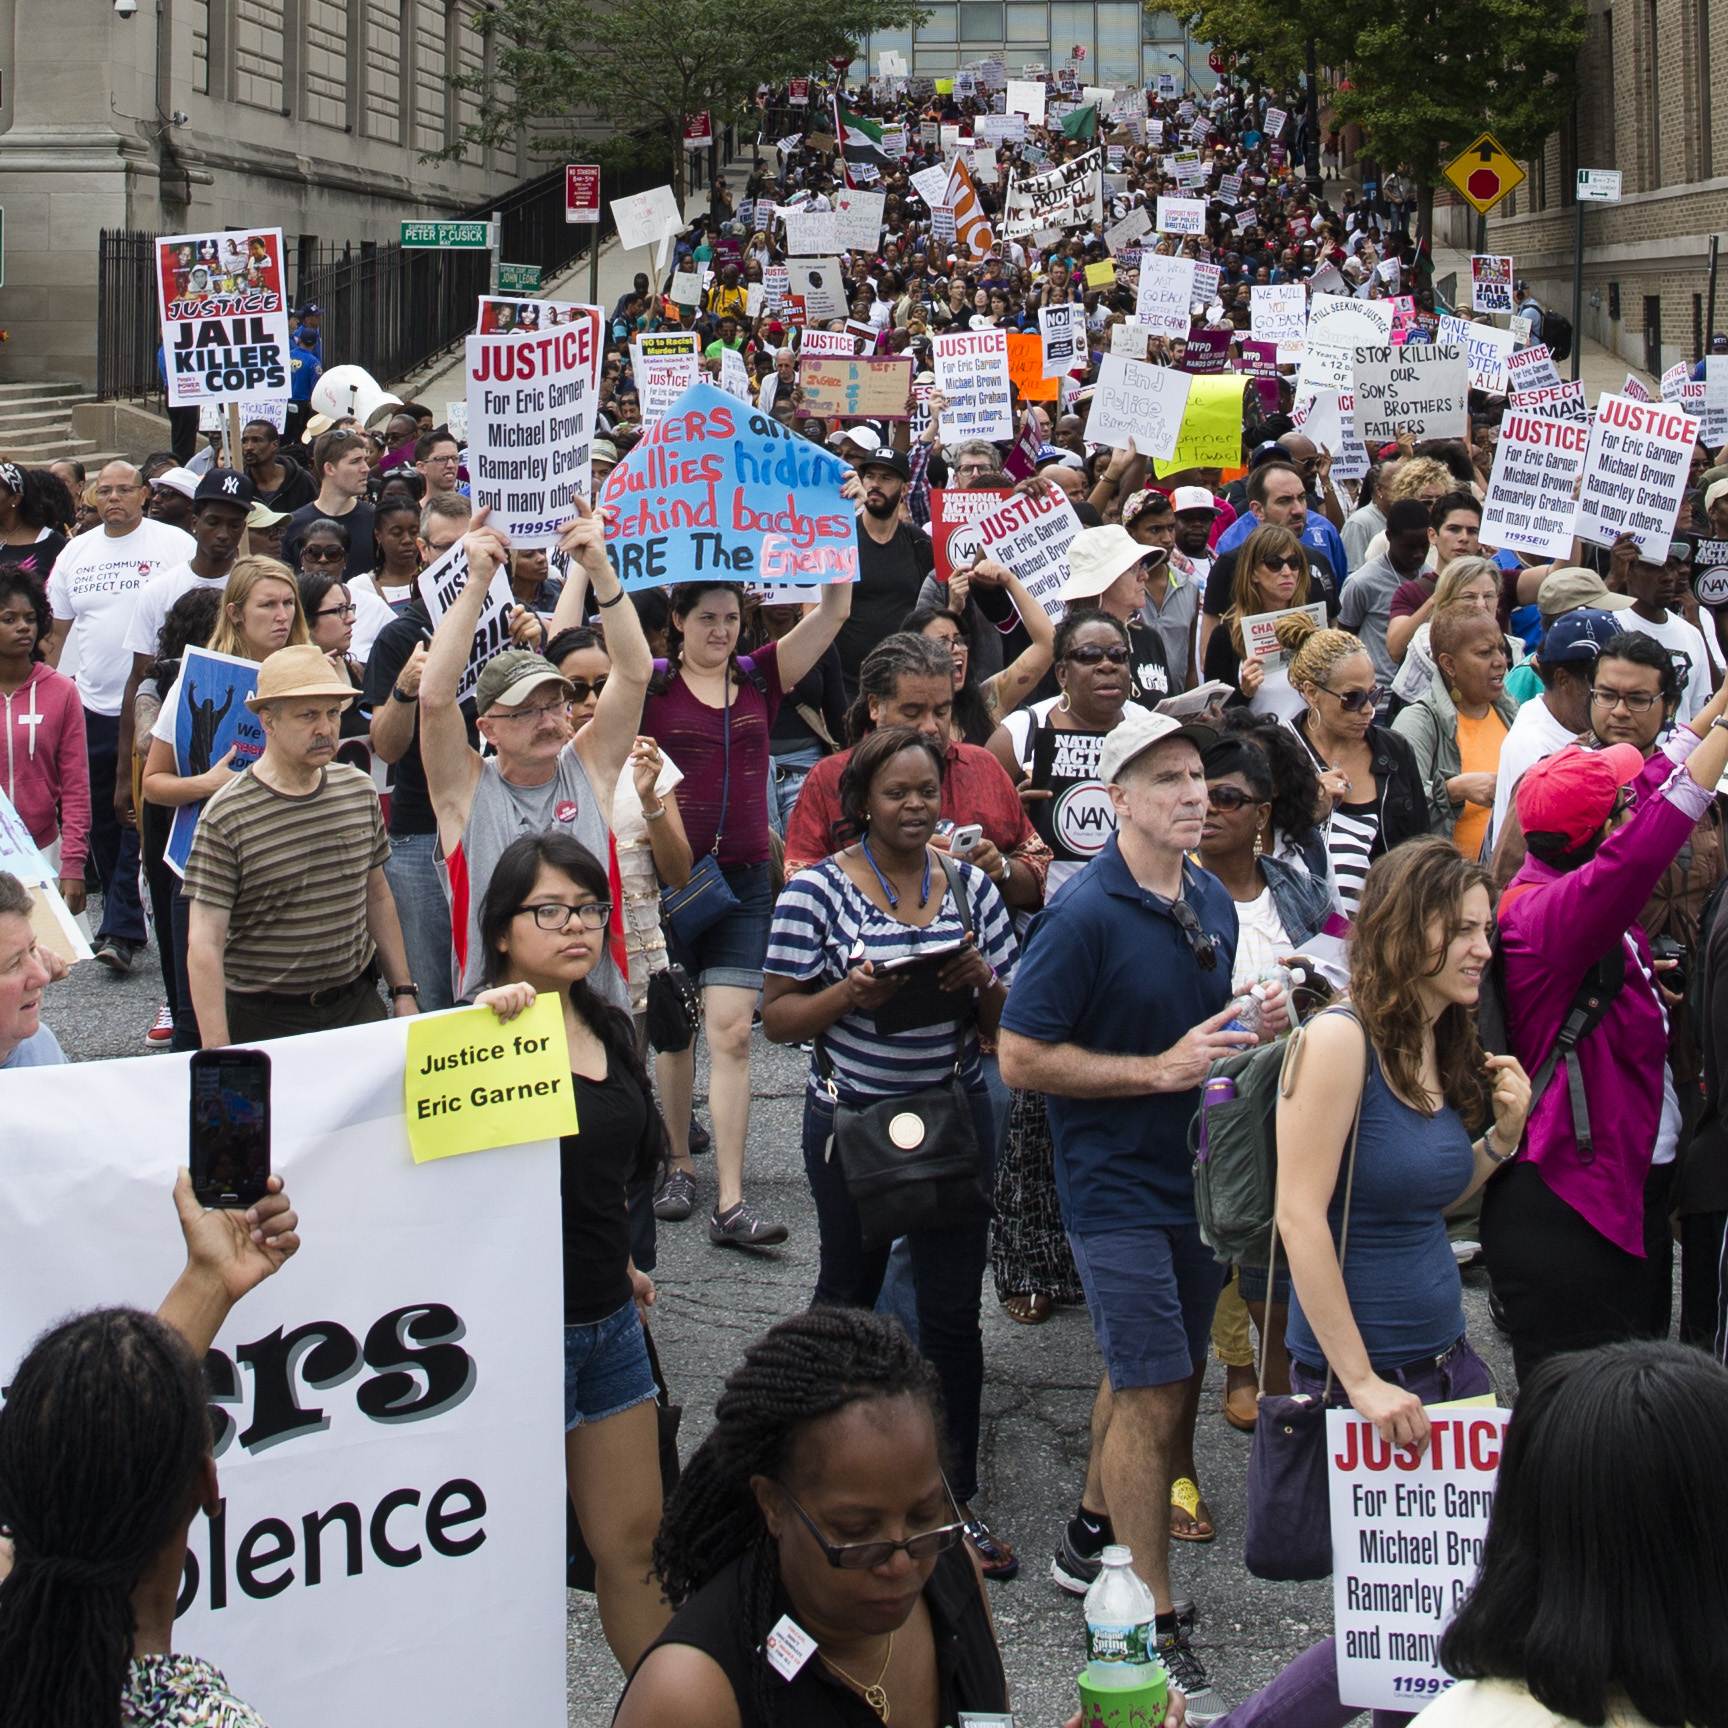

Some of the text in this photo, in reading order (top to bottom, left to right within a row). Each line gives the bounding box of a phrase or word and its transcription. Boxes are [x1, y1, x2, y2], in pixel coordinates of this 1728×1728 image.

[1032, 176, 1088, 207] PROJECT
[405, 230, 482, 241] PETER CUSICK
[501, 273, 538, 284] JOHN LEONE
[1477, 284, 1508, 294] JAIL
[168, 293, 279, 320] JUSTICE
[1477, 293, 1509, 303] KILLER
[1486, 301, 1511, 309] COPS
[1047, 310, 1069, 327] NO!
[1311, 302, 1389, 334] STILL SEEKING JUSTICE
[174, 317, 274, 350] JAIL
[937, 334, 1005, 358] JUSTICE
[1187, 341, 1211, 351] NYPD
[174, 345, 280, 374] KILLER
[473, 327, 590, 382] JUSTICE
[943, 358, 1001, 373] For Eric Garner
[1356, 345, 1459, 364] STOP KILLING
[206, 366, 286, 392] COPS
[1390, 367, 1420, 381] OUR
[1475, 373, 1503, 391] ALL
[485, 378, 584, 414] For Eric Garner
[1360, 383, 1398, 399] SONS
[1510, 381, 1582, 408] RESPECT
[1384, 398, 1452, 417] BROTHERS
[488, 412, 583, 447] Michael Brown
[1365, 420, 1425, 436] FATHERS
[1599, 401, 1697, 444] JUSTICE
[1601, 430, 1683, 465] For Eric Garner
[479, 443, 589, 481] Ramarley Graham
[1598, 454, 1675, 488] Michael Brown
[478, 489, 546, 515] and many
[1587, 474, 1677, 512] Ramarley Graham
[980, 487, 1065, 545] JUSTICE
[1582, 497, 1625, 526] and many
[996, 514, 1068, 563] For Eric Garner
[690, 533, 858, 584] The Enemy
[97, 572, 120, 580] CITY
[120, 580, 139, 589] FOR
[1066, 806, 1116, 830] NAN
[421, 1036, 549, 1075] Justice for
[418, 1079, 561, 1119] Eric Garner
[1352, 1484, 1435, 1517] For Eric
[1360, 1530, 1438, 1565] Michael
[1093, 1637, 1128, 1655] Spring
